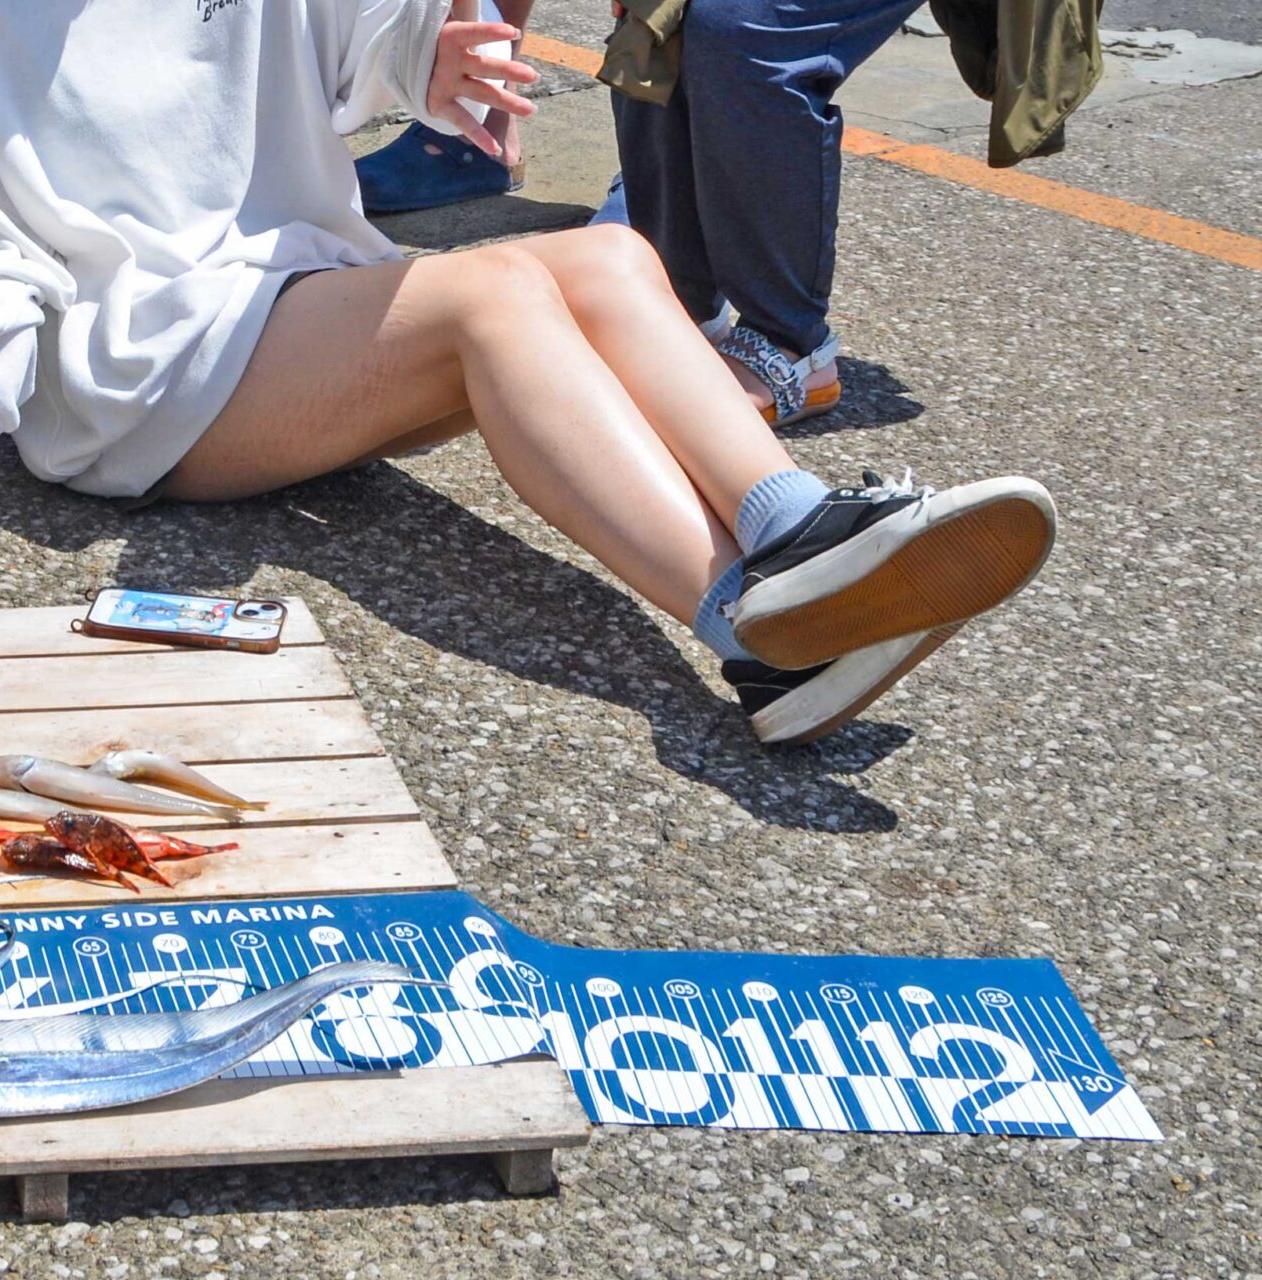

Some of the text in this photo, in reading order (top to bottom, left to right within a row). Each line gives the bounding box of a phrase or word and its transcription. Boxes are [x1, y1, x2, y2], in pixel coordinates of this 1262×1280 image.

[101, 911, 179, 929] SIDE
[191, 904, 335, 925] MARINA
[81, 941, 102, 952] 65
[161, 938, 181, 948] 70
[238, 934, 259, 945] 75
[317, 931, 337, 942] 80
[394, 926, 414, 937] 85
[518, 965, 537, 982] 95
[592, 983, 616, 993] 100
[669, 983, 695, 995] 105
[748, 986, 773, 997] 110
[825, 988, 850, 999] 115
[904, 990, 929, 1001] 120
[981, 992, 1008, 1004] 125
[1071, 1075, 1114, 1094] 130
